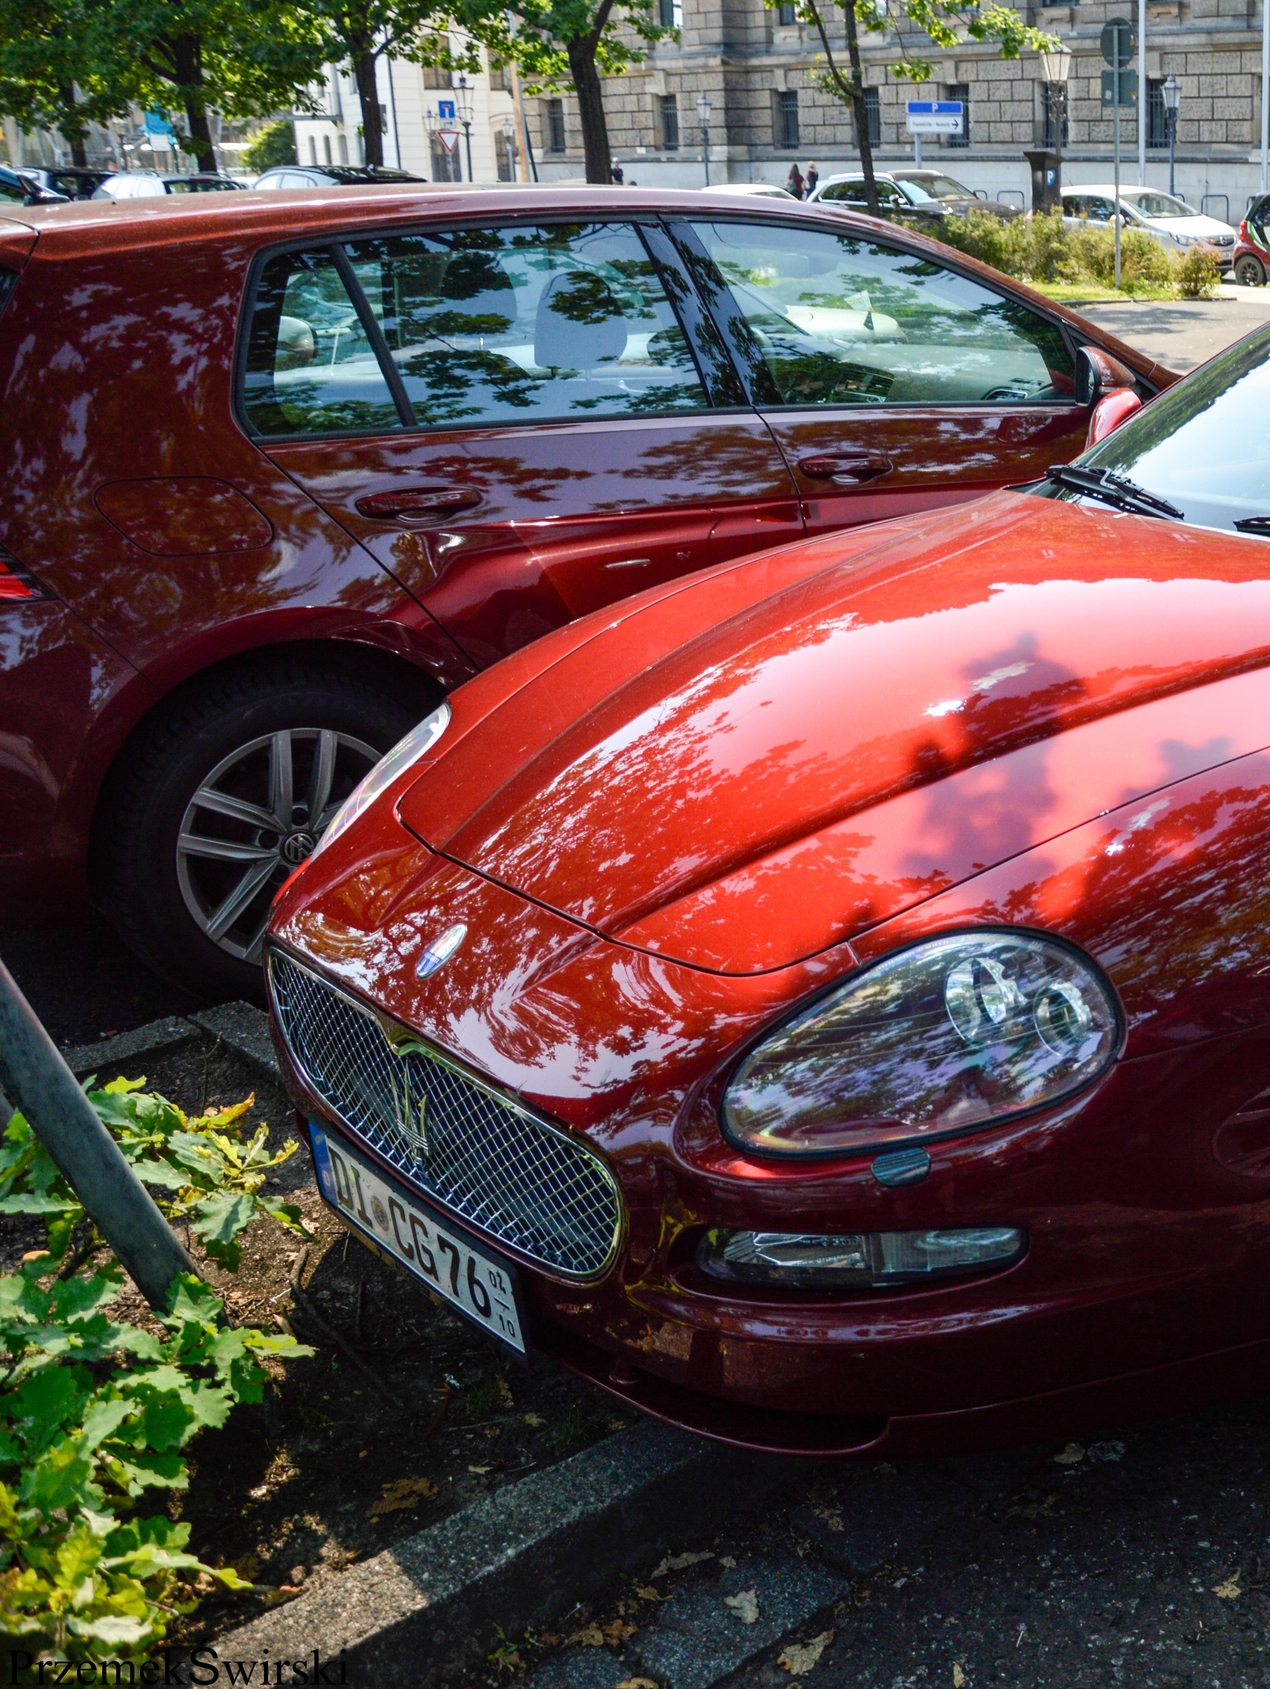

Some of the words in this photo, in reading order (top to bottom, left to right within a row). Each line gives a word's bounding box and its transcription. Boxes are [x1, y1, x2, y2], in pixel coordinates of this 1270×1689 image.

[931, 102, 939, 113] P
[1047, 170, 1054, 184] P
[330, 1145, 374, 1229] DI
[498, 1313, 516, 1338] 10
